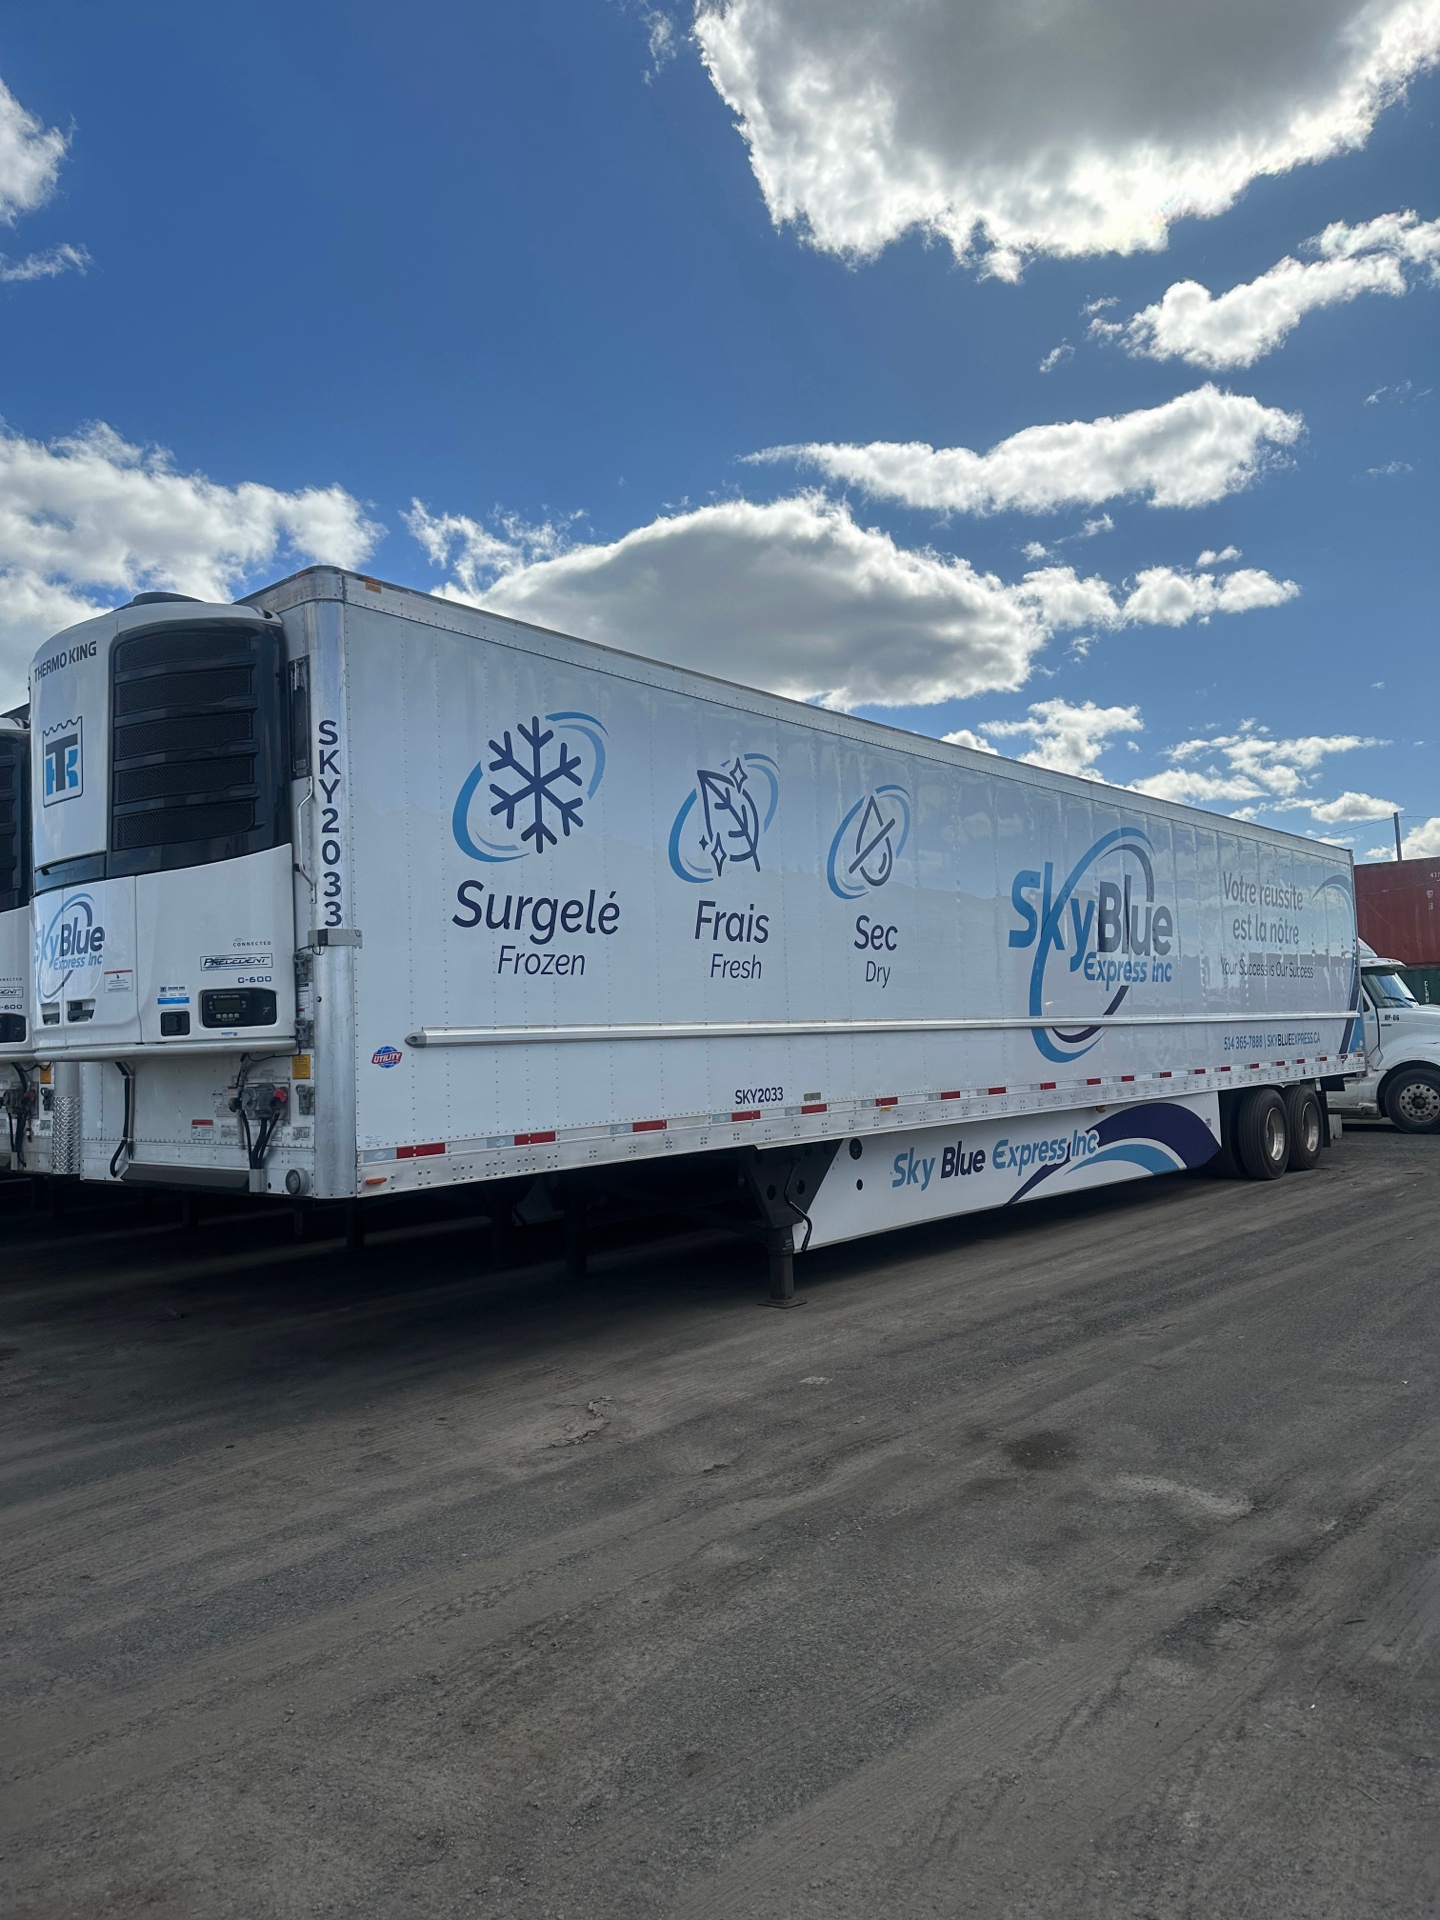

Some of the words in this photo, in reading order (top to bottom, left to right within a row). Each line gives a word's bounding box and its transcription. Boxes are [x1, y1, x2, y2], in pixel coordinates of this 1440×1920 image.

[34, 651, 67, 683] THERMO
[69, 640, 97, 665] KING
[318, 720, 343, 927] SKY2033
[1223, 871, 1256, 904] Votre
[1259, 879, 1303, 911] réussite
[451, 880, 621, 945] Surgelé
[694, 900, 770, 944] Frais
[854, 915, 898, 951] Sec
[1233, 914, 1252, 941] est
[1255, 914, 1267, 942] la
[1270, 917, 1299, 945] nôtre
[54, 956, 86, 971] Express
[497, 945, 586, 977] Frozen
[709, 953, 762, 979] Fresh
[865, 961, 891, 989] Dry
[1083, 954, 1148, 991] Express
[1220, 955, 1238, 975] Your
[1239, 959, 1268, 977] Success
[1275, 961, 1288, 977] Our
[1289, 962, 1314, 979] Success
[238, 976, 272, 984] C-600
[1224, 1036, 1235, 1051] 514
[1235, 1035, 1263, 1050] 365-7888
[1267, 1031, 1321, 1048] SKYBLUEEXPRESS.CA
[373, 1052, 401, 1063] UTILITY
[734, 1086, 784, 1105] SKY2033
[891, 1147, 936, 1191] Sky
[941, 1141, 986, 1178] Blue
[992, 1138, 1066, 1176] Express
[1071, 1129, 1099, 1157] Inc
